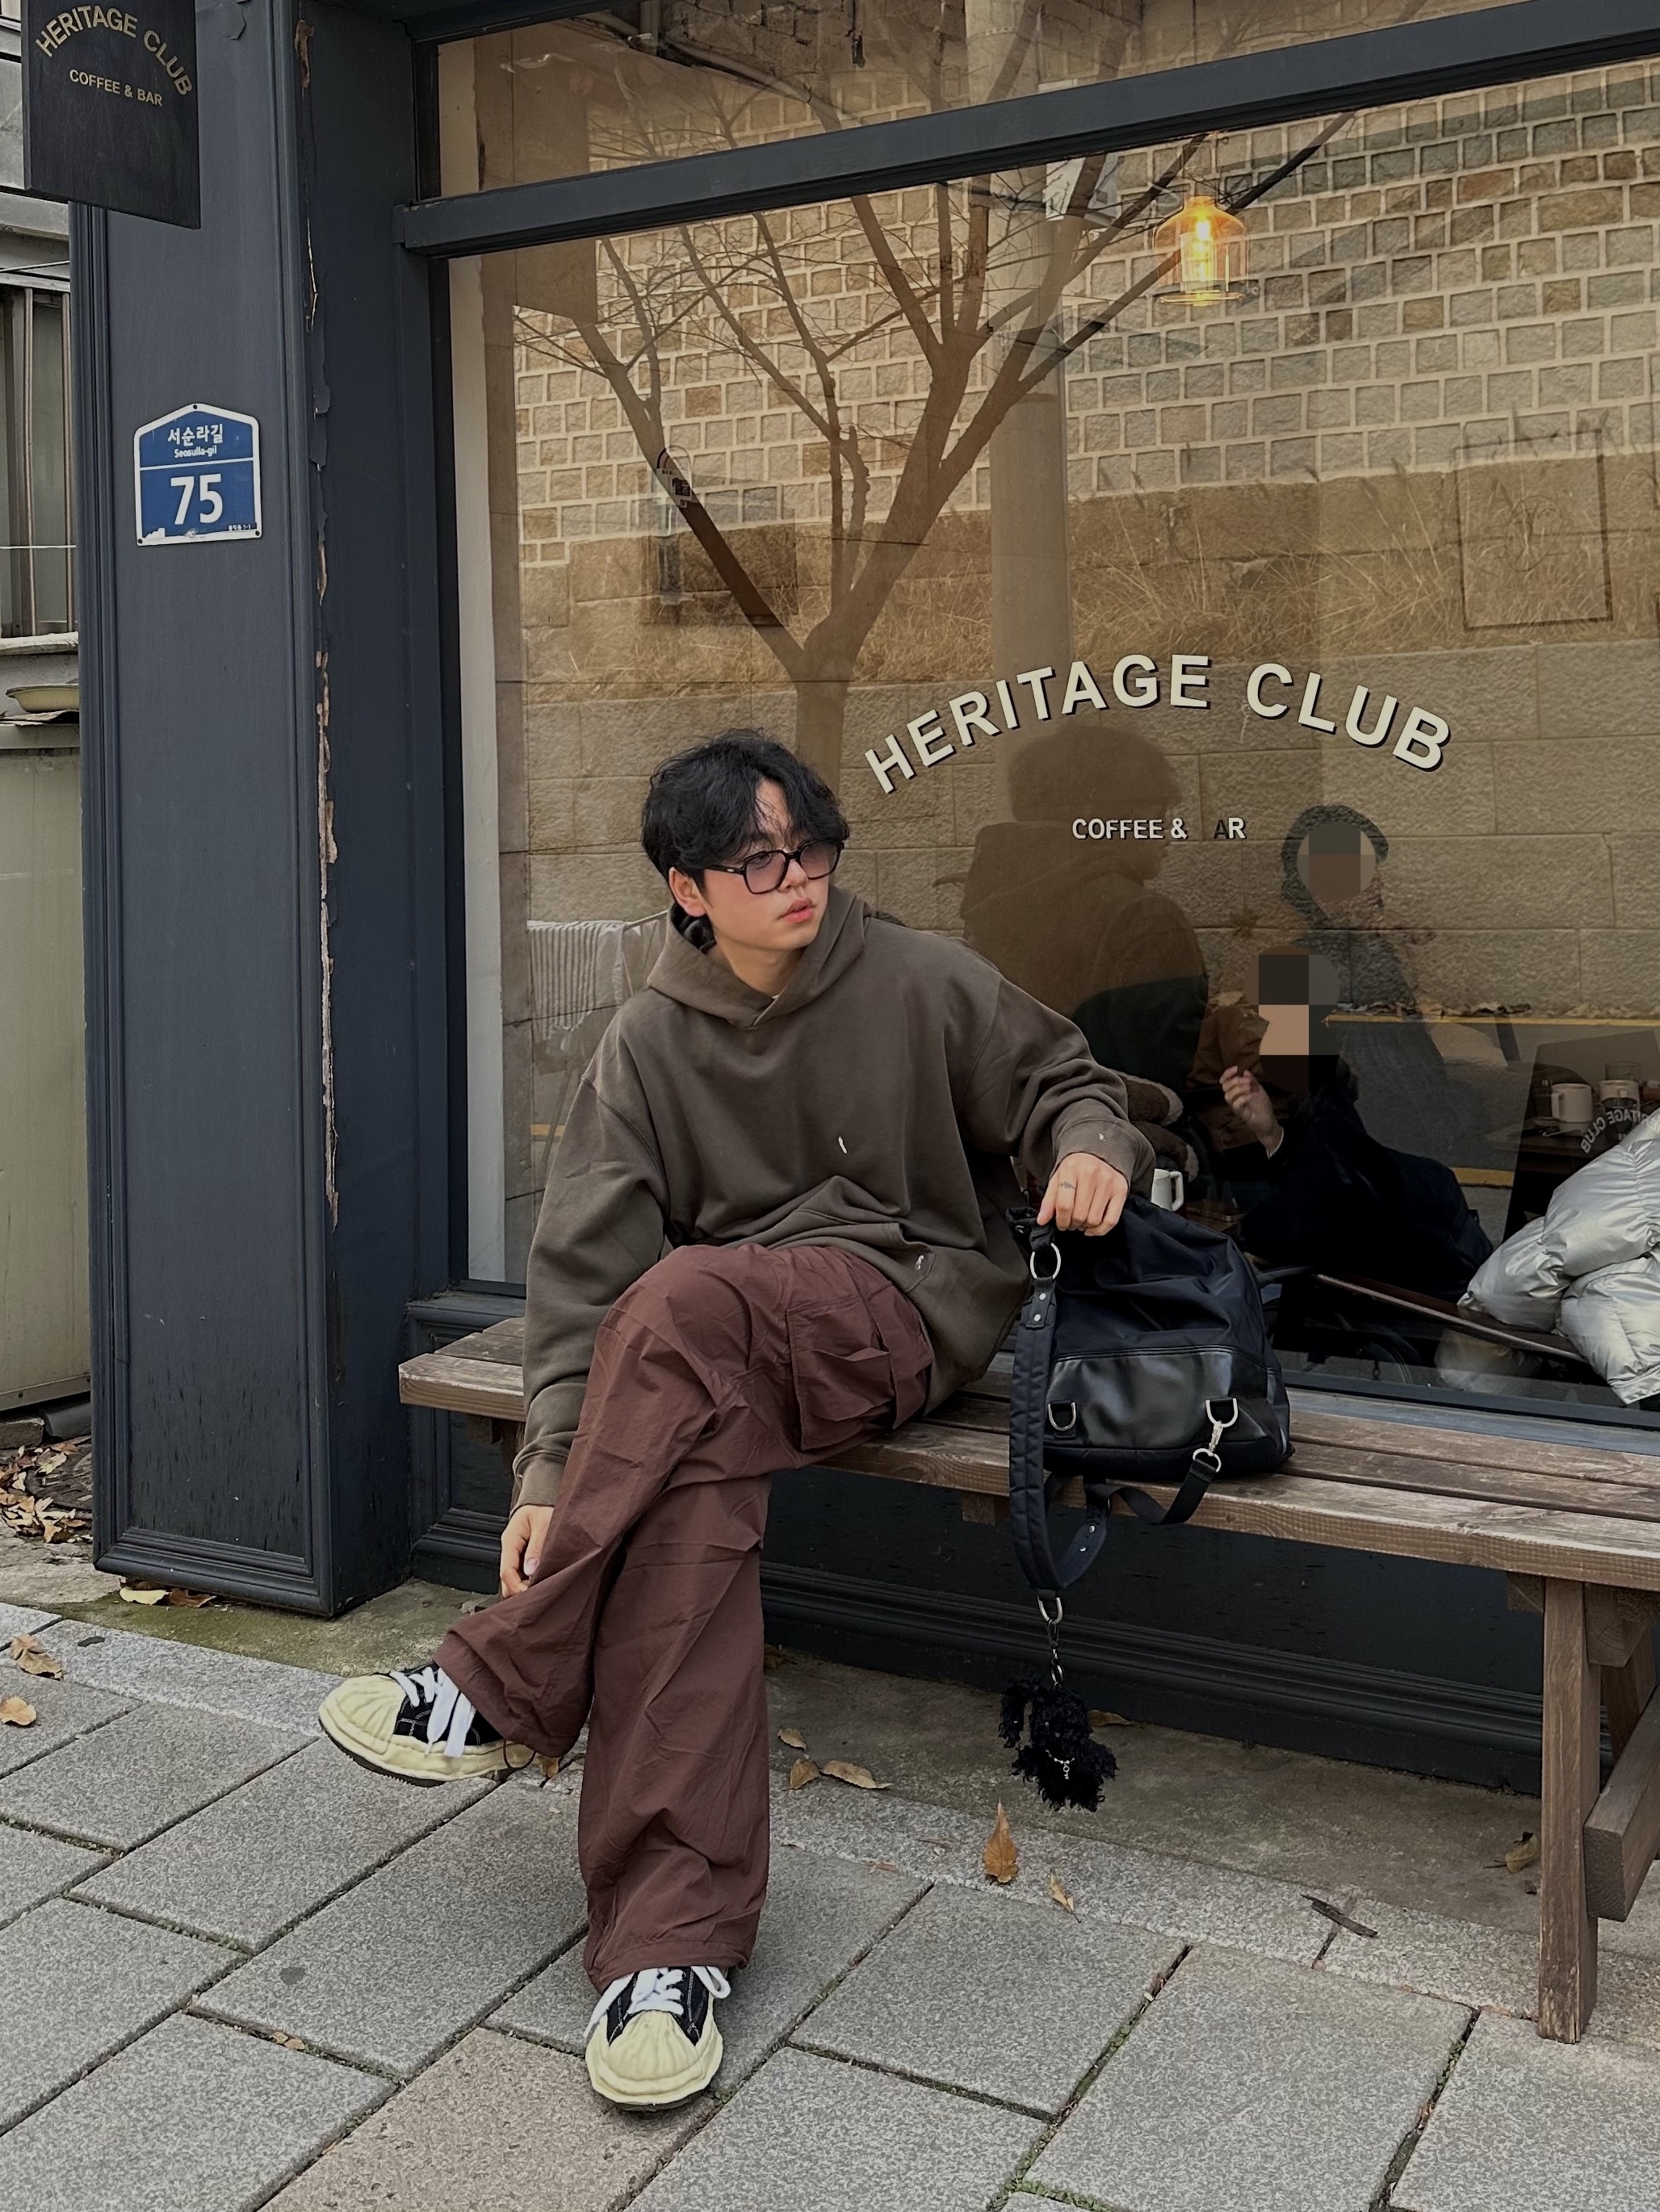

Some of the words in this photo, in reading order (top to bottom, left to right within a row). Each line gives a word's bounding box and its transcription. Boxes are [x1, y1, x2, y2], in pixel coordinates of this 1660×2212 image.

[36, 5, 137, 57] HERITAGE
[143, 30, 193, 95] CLUB
[69, 69, 120, 94] COFFEE
[124, 84, 133, 98] &
[137, 88, 163, 107] BAR
[167, 423, 224, 446] 서순라길
[174, 445, 217, 458] Seosulla-gil
[170, 473, 223, 525] 75
[864, 654, 1212, 794] HERITAGE
[1246, 662, 1452, 773] CLUB
[1072, 817, 1165, 840] COFFEE
[1170, 817, 1189, 840] &
